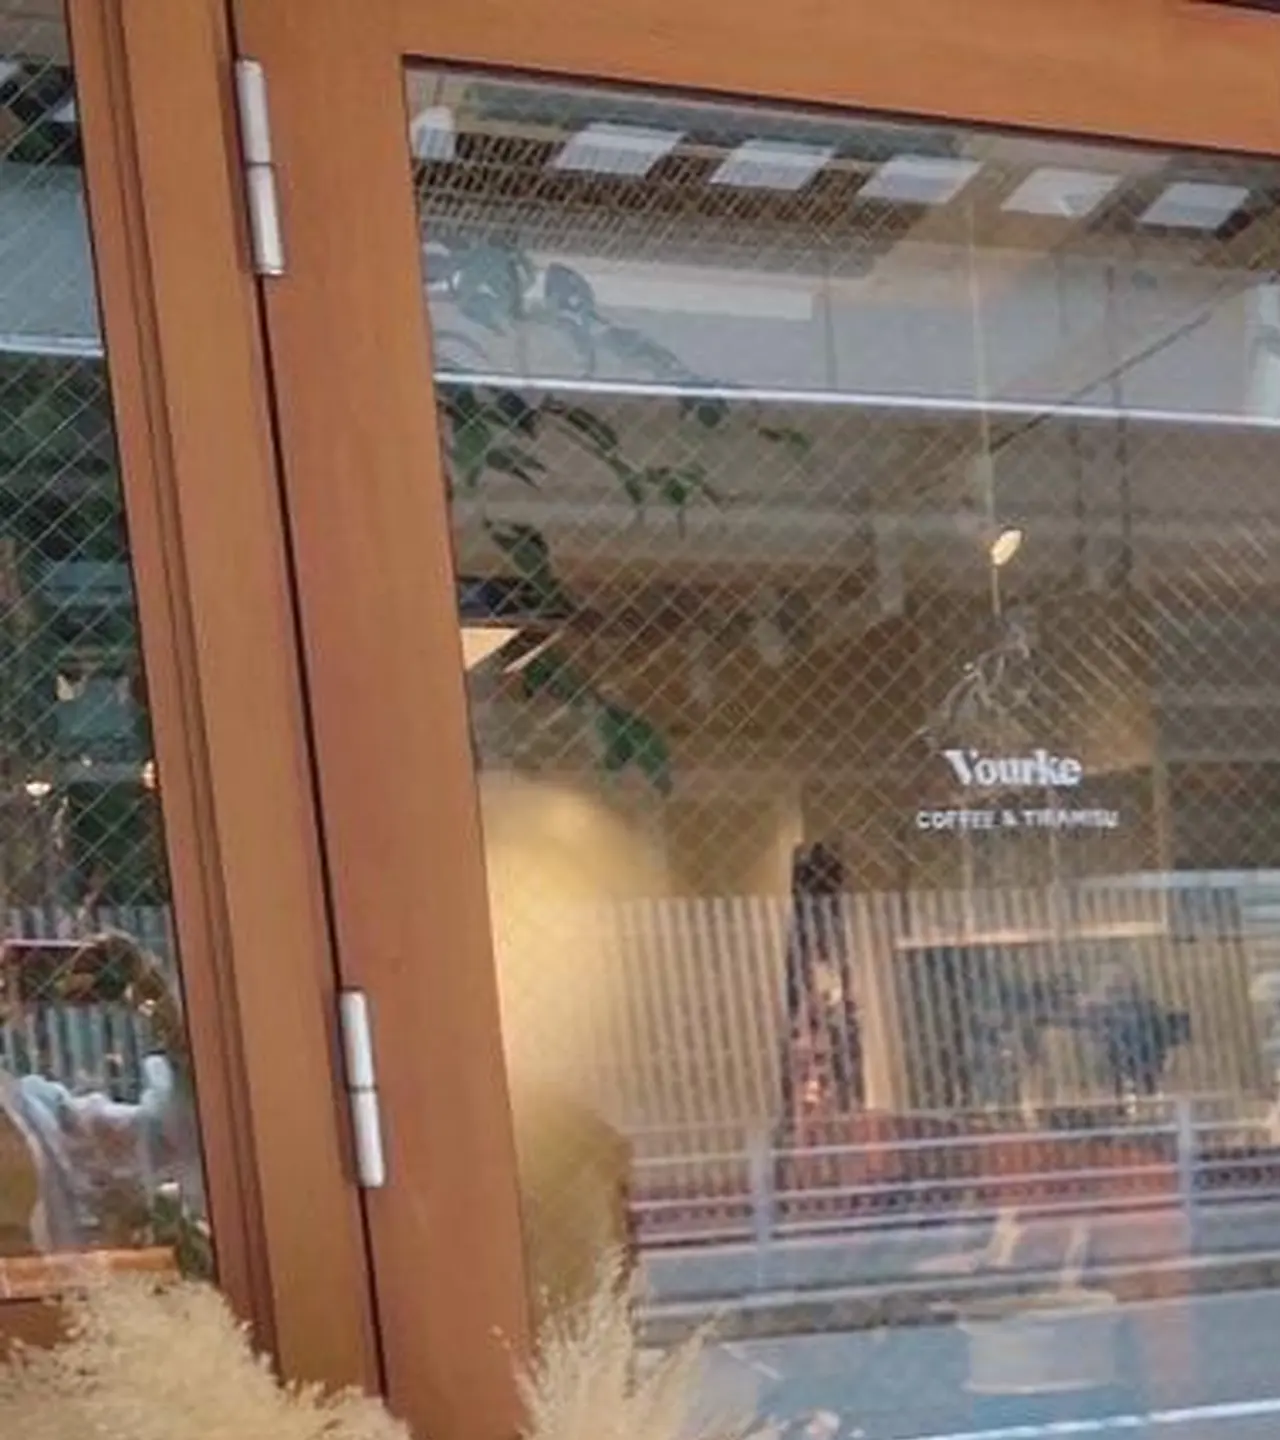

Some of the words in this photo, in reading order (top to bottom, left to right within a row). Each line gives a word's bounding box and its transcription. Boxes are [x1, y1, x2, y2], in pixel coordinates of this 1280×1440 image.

[943, 748, 1083, 786] Vourke
[916, 809, 996, 829] COFFEE
[1001, 811, 1018, 828] &
